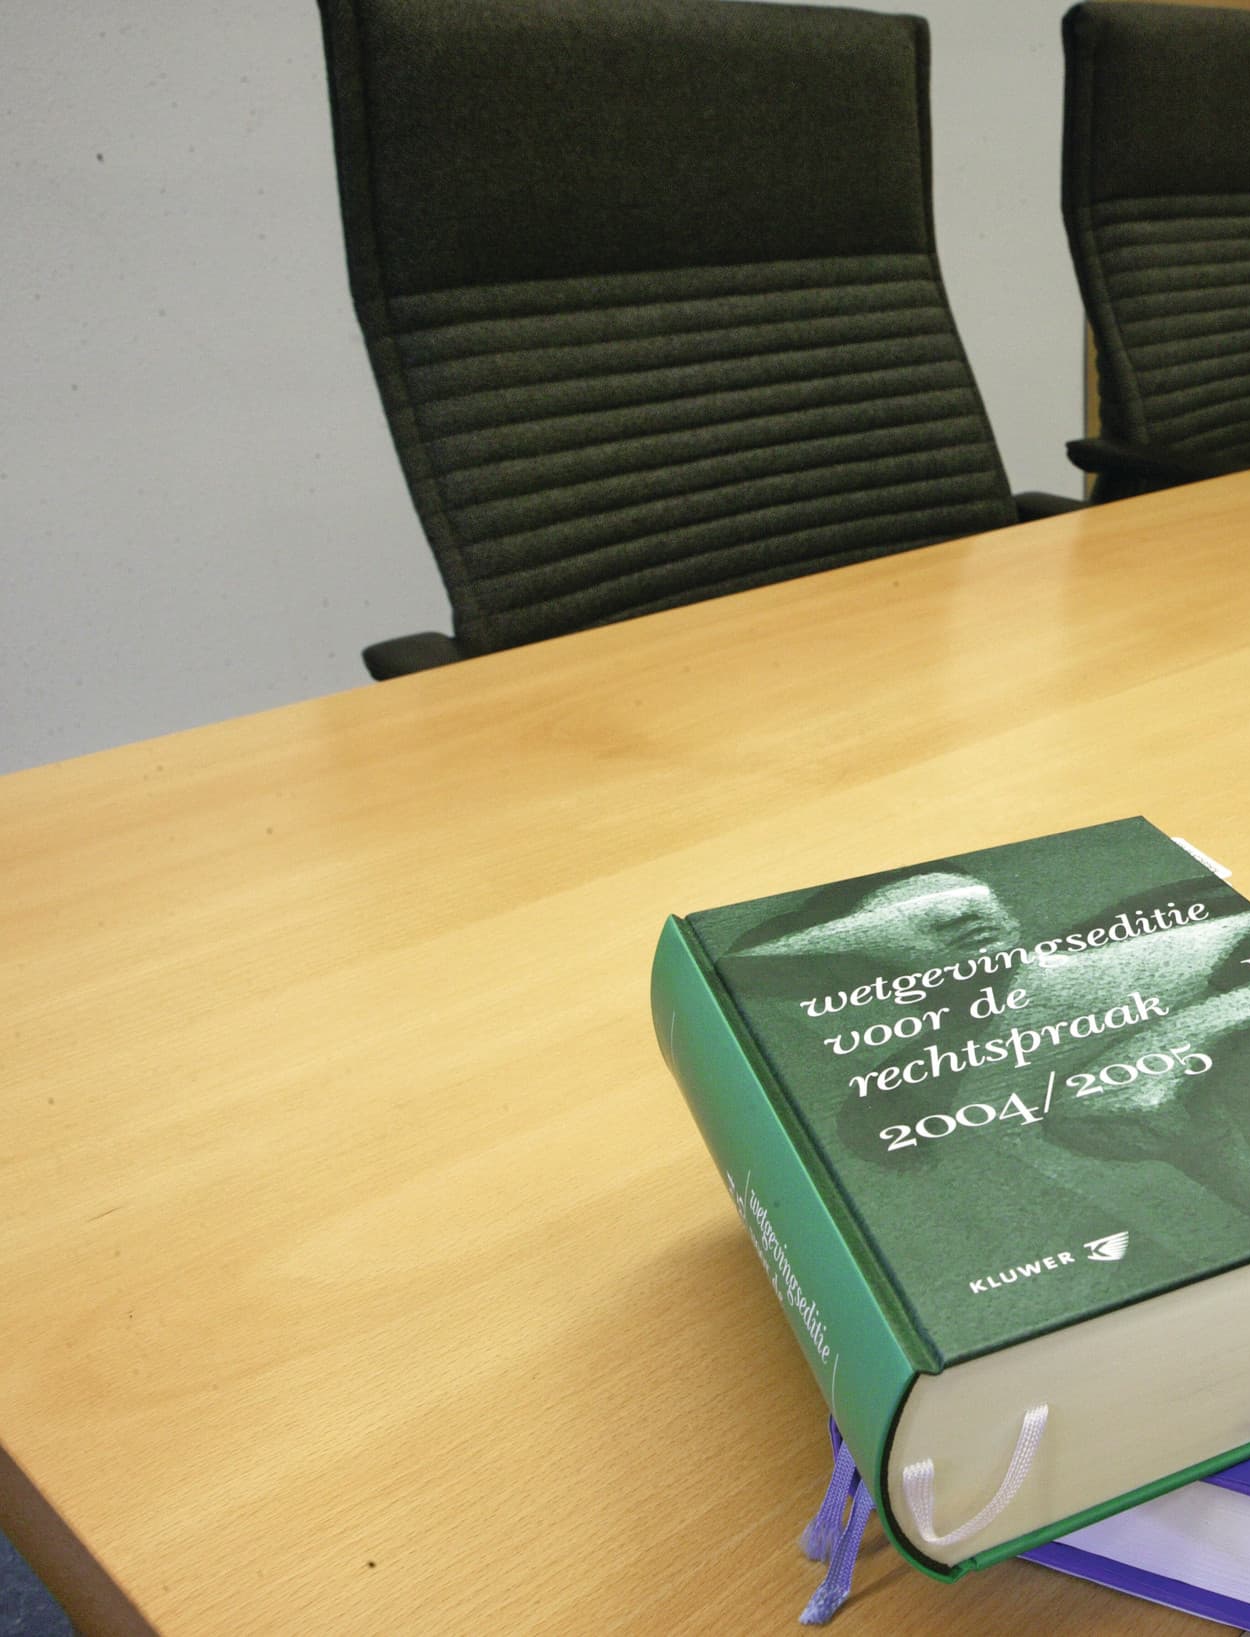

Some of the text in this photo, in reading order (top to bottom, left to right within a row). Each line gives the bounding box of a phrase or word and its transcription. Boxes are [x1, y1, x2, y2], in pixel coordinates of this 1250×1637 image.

[800, 902, 1210, 1018] wetgevingseditie
[823, 988, 1030, 1056] voor de
[848, 990, 1170, 1098] rechtspraak
[749, 1188, 831, 1364] wetgevingseditie
[969, 1251, 1076, 1294] KLUWER
